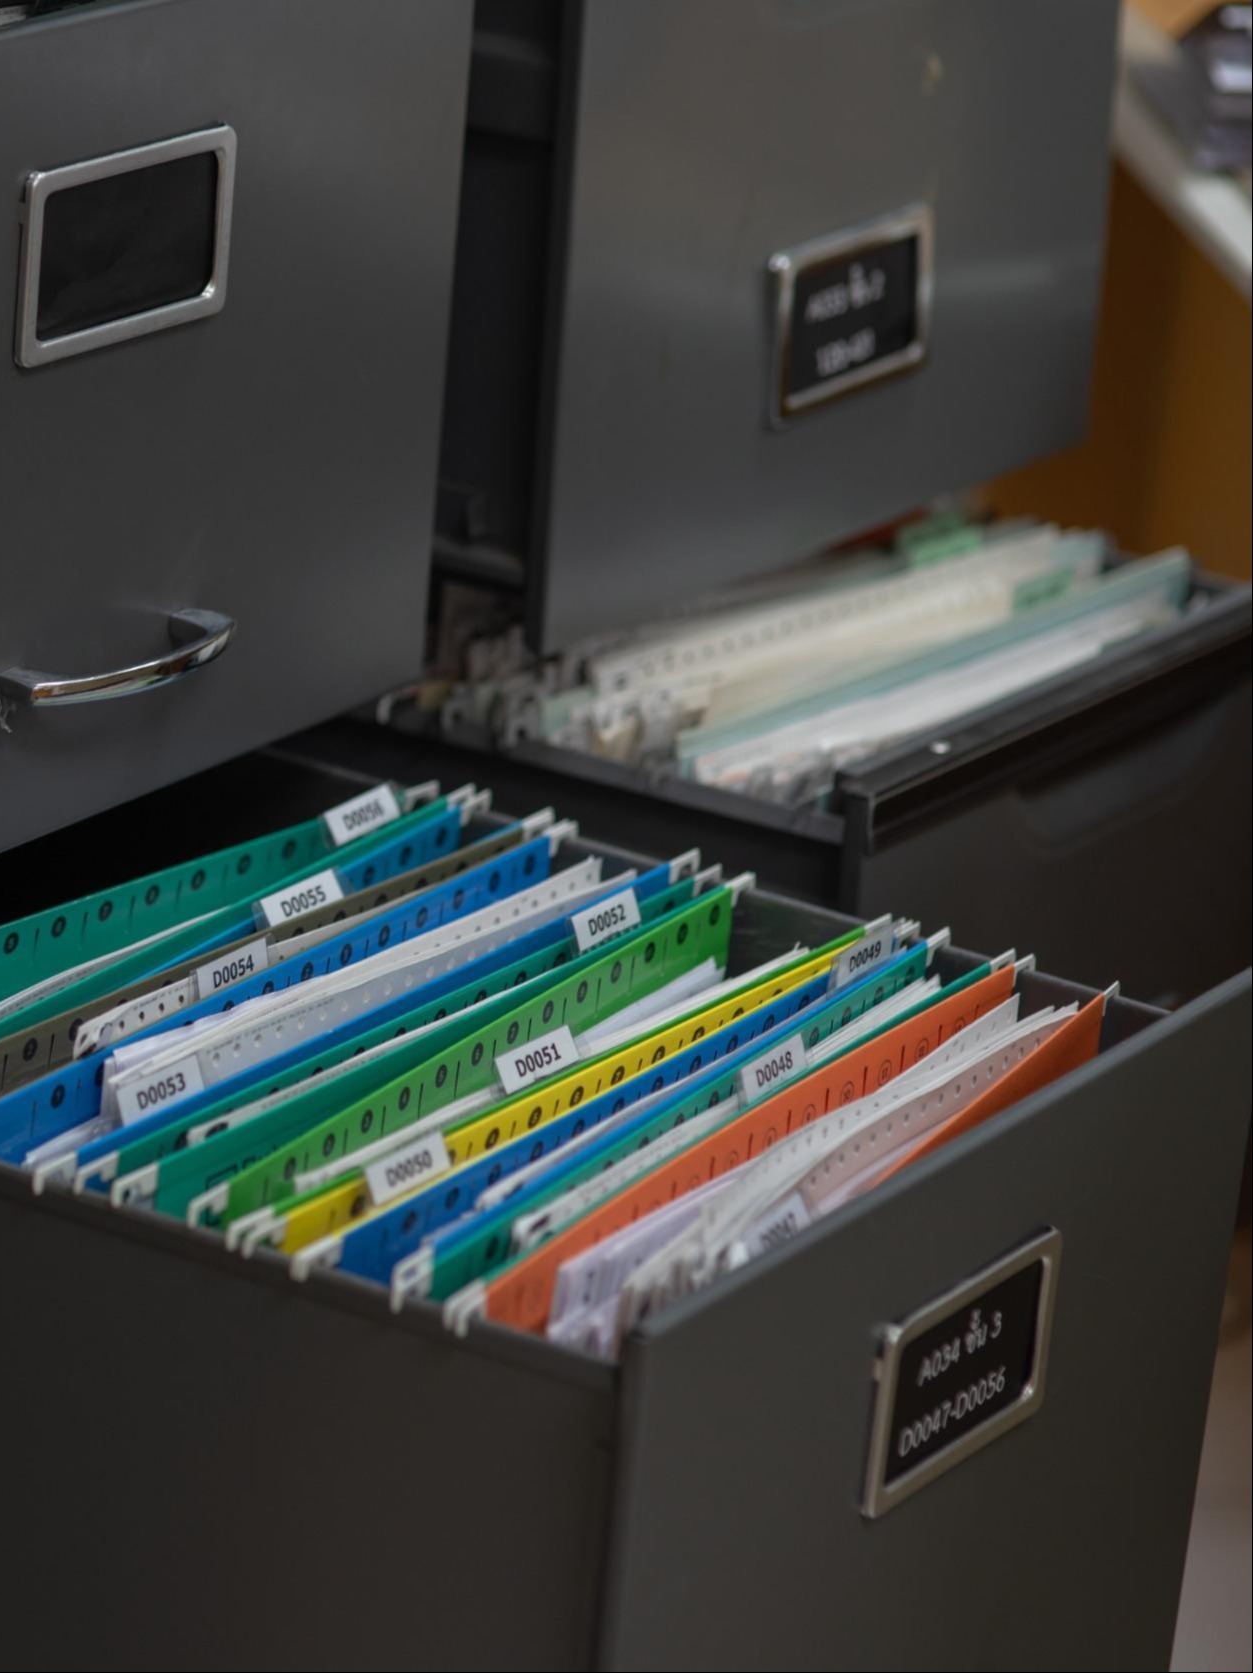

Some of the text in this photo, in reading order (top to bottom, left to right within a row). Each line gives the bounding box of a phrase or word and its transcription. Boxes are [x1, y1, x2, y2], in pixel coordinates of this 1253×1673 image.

[342, 803, 385, 831] D0056
[281, 885, 326, 918] D0055
[588, 903, 626, 936] D0052
[212, 954, 255, 989] D0054
[849, 941, 882, 973] D0049
[515, 1043, 562, 1077] D0051
[756, 1051, 793, 1088] D0048
[137, 1072, 186, 1110] D0053
[384, 1150, 433, 1189] D0050
[916, 1308, 1003, 1388] A034 ชั้น 3
[898, 1364, 1007, 1458] D0047-D0056
